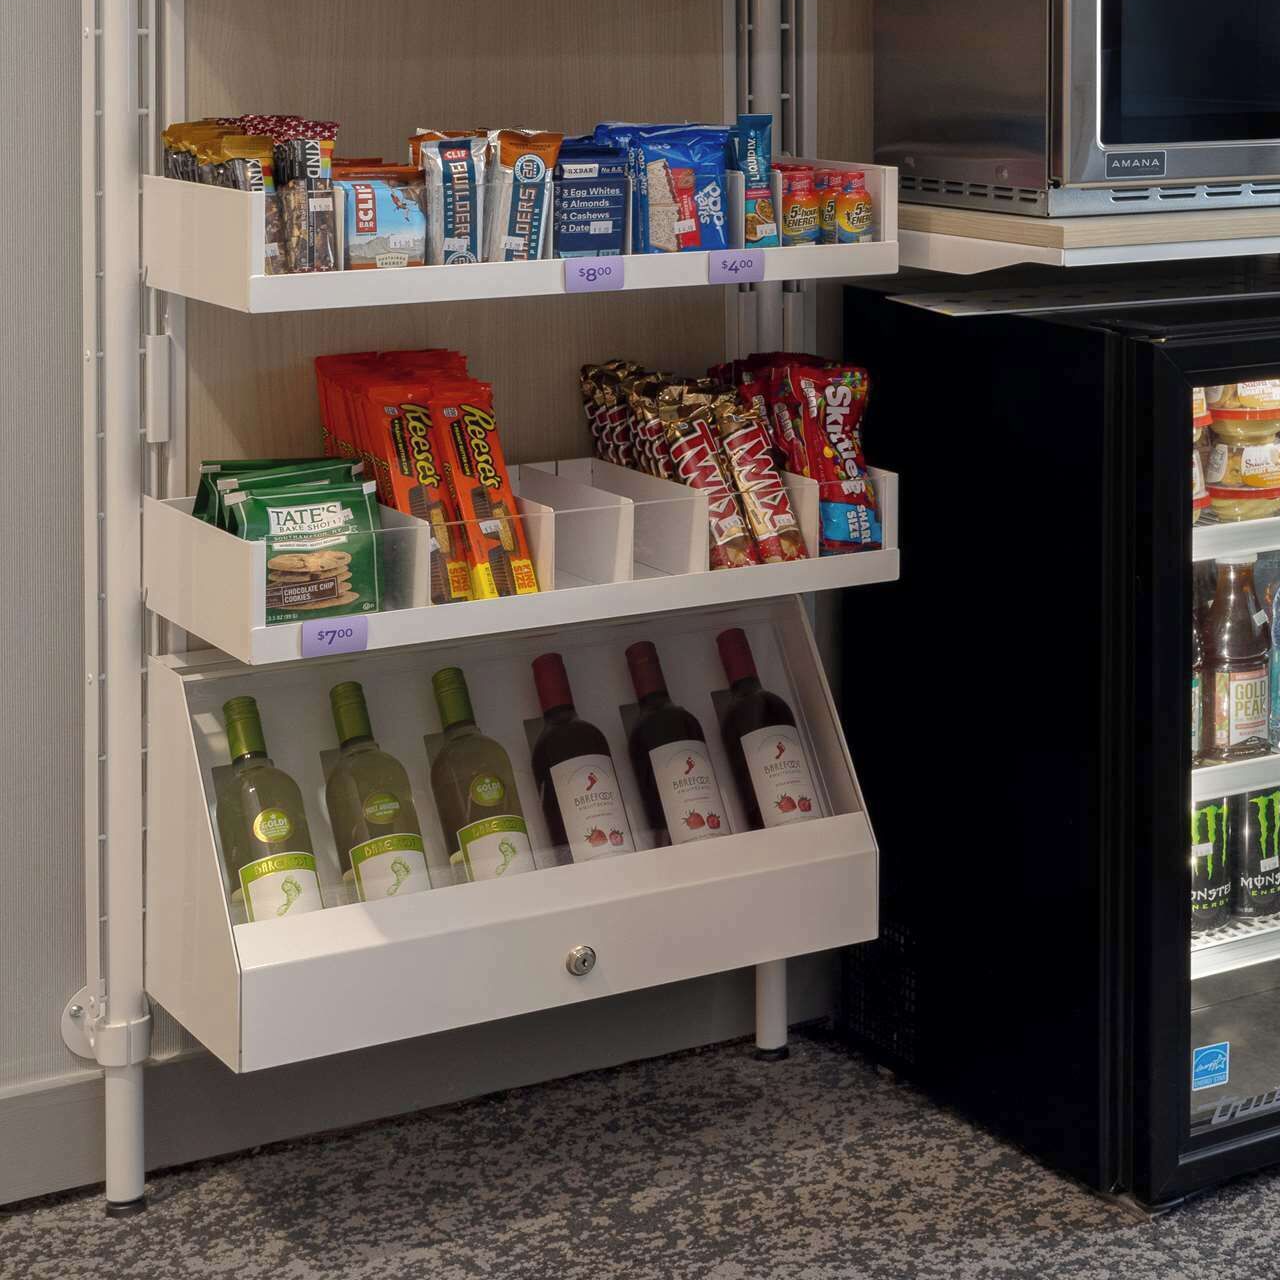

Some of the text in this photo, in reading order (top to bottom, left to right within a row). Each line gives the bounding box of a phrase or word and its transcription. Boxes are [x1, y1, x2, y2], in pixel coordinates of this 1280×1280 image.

[306, 139, 320, 178] KIND
[446, 151, 466, 159] CLIF
[1112, 159, 1159, 167] AMANA
[355, 185, 373, 220] CLIF
[570, 189, 587, 197] Egg
[589, 187, 620, 195] Whites
[788, 217, 818, 227] ENERGY
[400, 404, 440, 488] Reese's
[460, 404, 501, 489] Reese's
[671, 420, 744, 545] TWIX
[724, 420, 794, 537] TWIX
[272, 505, 337, 525] TATE'S
[847, 511, 859, 538] SIZE
[513, 565, 522, 589] SIZE
[284, 586, 318, 596] CHOCOLATE
[285, 594, 311, 603] COOKIES
[1235, 680, 1266, 701] GOLD
[1235, 700, 1267, 718] PEAK
